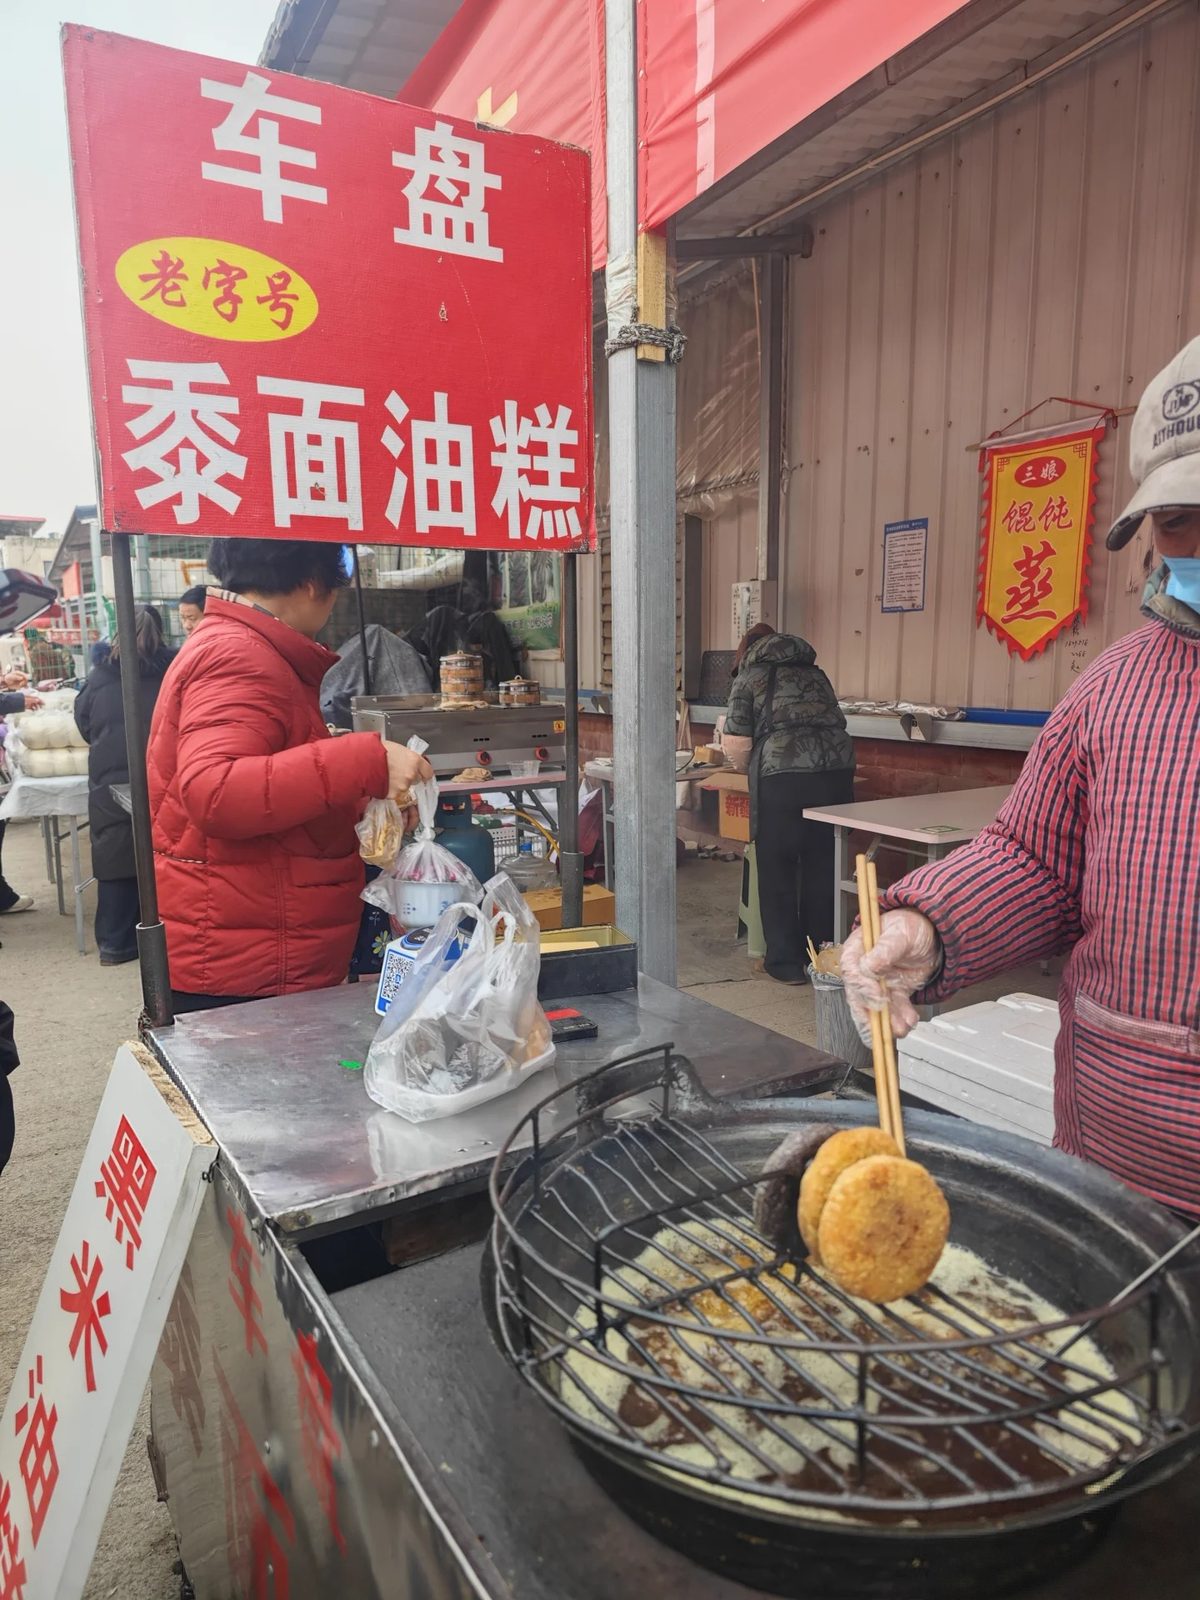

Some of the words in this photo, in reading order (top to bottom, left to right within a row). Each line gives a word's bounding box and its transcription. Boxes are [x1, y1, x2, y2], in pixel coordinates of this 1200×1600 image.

[201, 71, 503, 263] 车盘
[138, 250, 300, 331] 老字号
[121, 358, 582, 540] 黍面油糕
[1021, 460, 1059, 484] 三娘
[1002, 496, 1073, 535] 馄饨
[1000, 540, 1058, 625] 蒸
